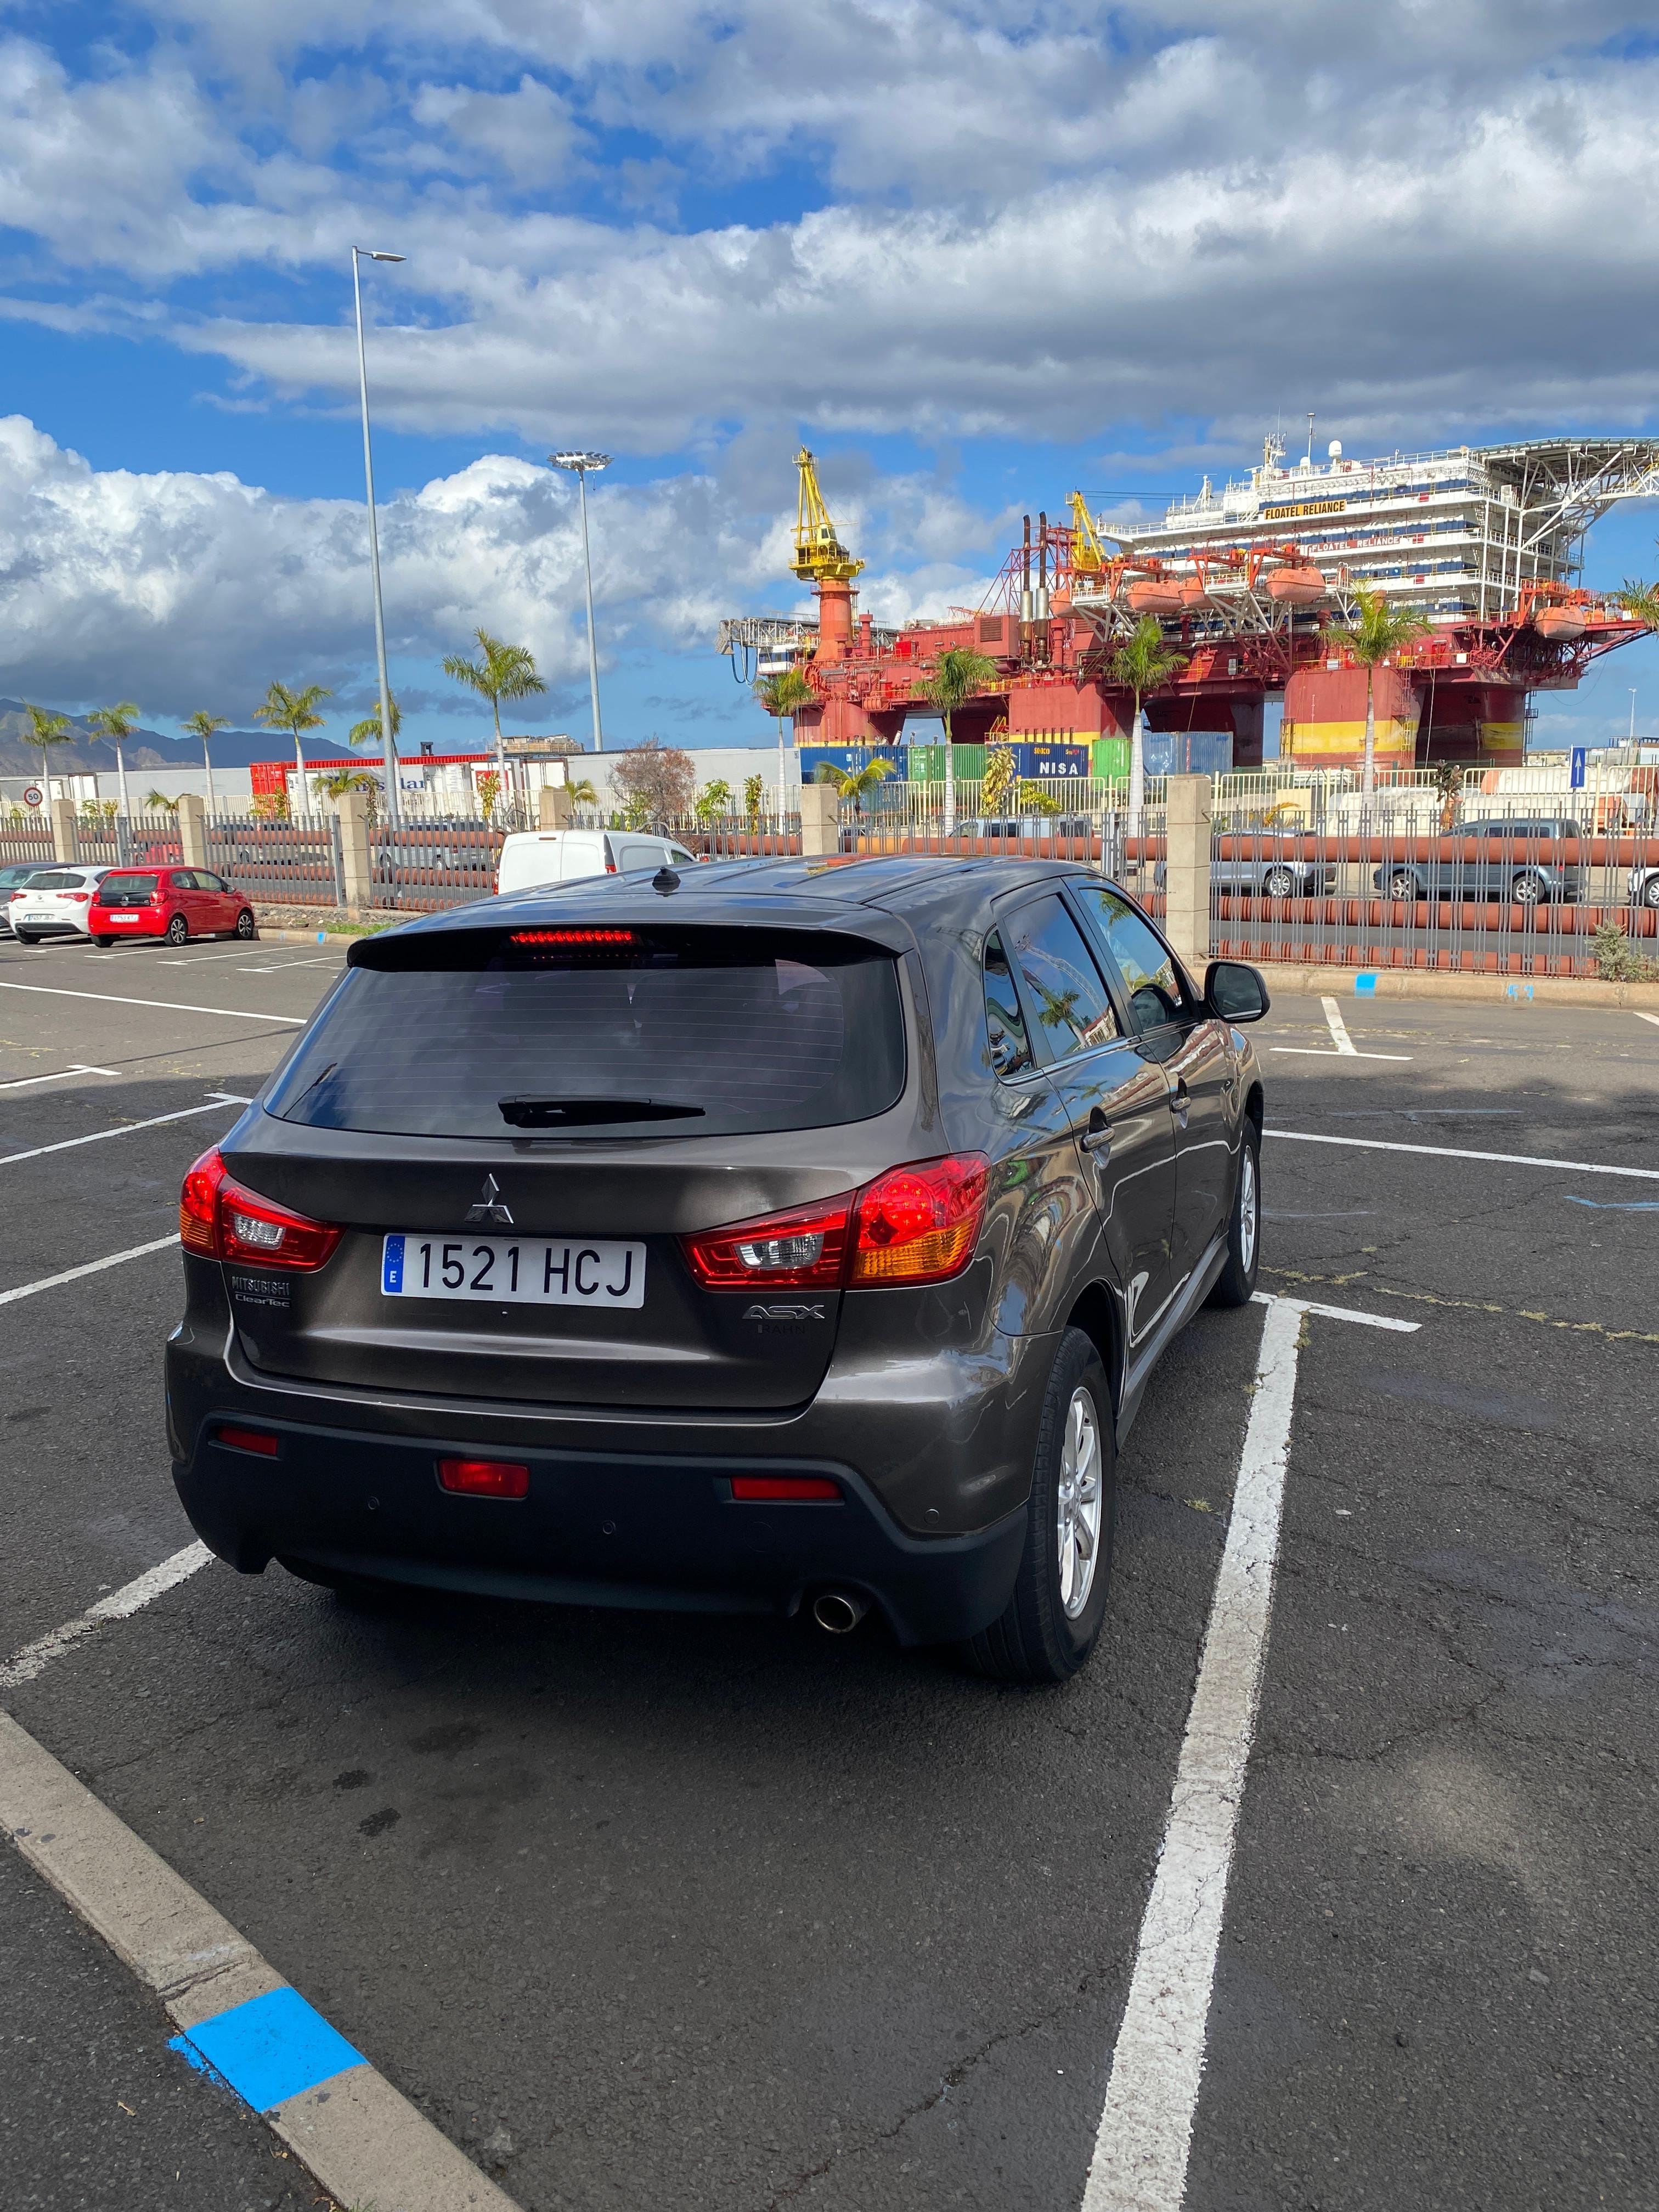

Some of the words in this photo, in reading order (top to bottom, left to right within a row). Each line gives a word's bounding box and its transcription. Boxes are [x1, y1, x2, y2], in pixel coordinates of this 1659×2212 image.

[1266, 506, 1300, 520] FLOATEL
[1303, 501, 1345, 515] RELIANCE
[1312, 541, 1350, 552] FLOATEL
[1357, 536, 1400, 548] RELIANCE
[1040, 761, 1078, 775] NISA
[390, 1271, 397, 1283] E
[420, 1243, 519, 1291] 1521
[544, 1248, 633, 1296] HCJ
[232, 1276, 290, 1295] MITSUBISHI
[235, 1294, 290, 1307] ClearTec
[742, 1305, 825, 1319] ASX
